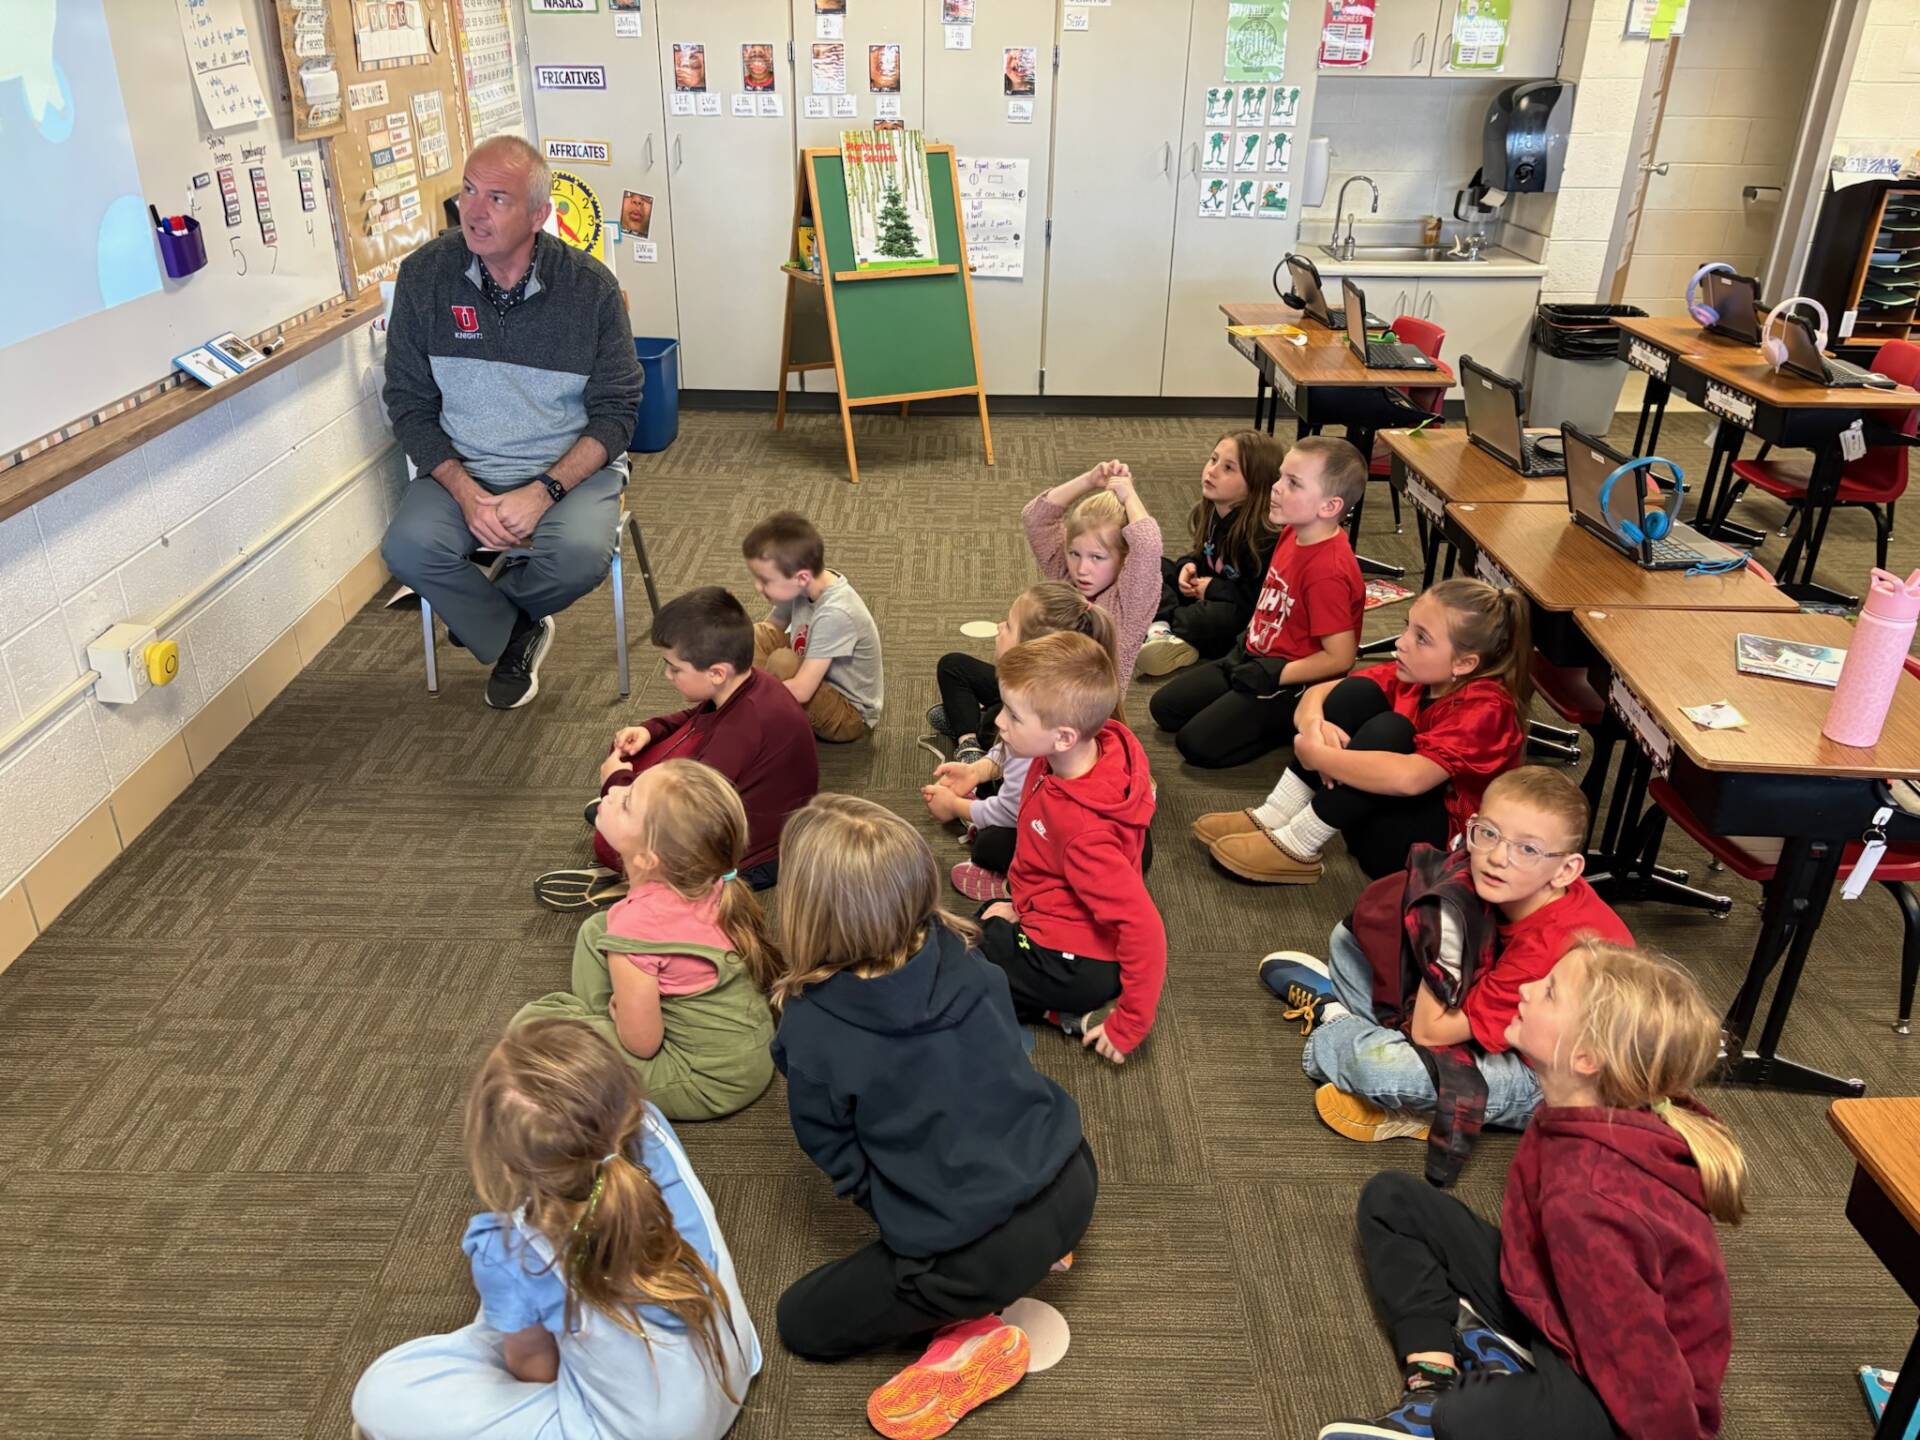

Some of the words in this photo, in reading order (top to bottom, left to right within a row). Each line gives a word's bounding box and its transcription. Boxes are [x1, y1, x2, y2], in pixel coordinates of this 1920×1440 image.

[542, 71, 600, 85] FRICATIVES
[549, 144, 606, 159] AFFRICATES
[875, 143, 892, 151] and
[864, 153, 898, 163] Seasons
[570, 184, 574, 195] 1
[582, 198, 589, 209] 2
[588, 215, 595, 226] 3
[583, 233, 589, 243] 4
[230, 236, 247, 276] 5
[266, 245, 278, 274] 7
[452, 305, 479, 332] U
